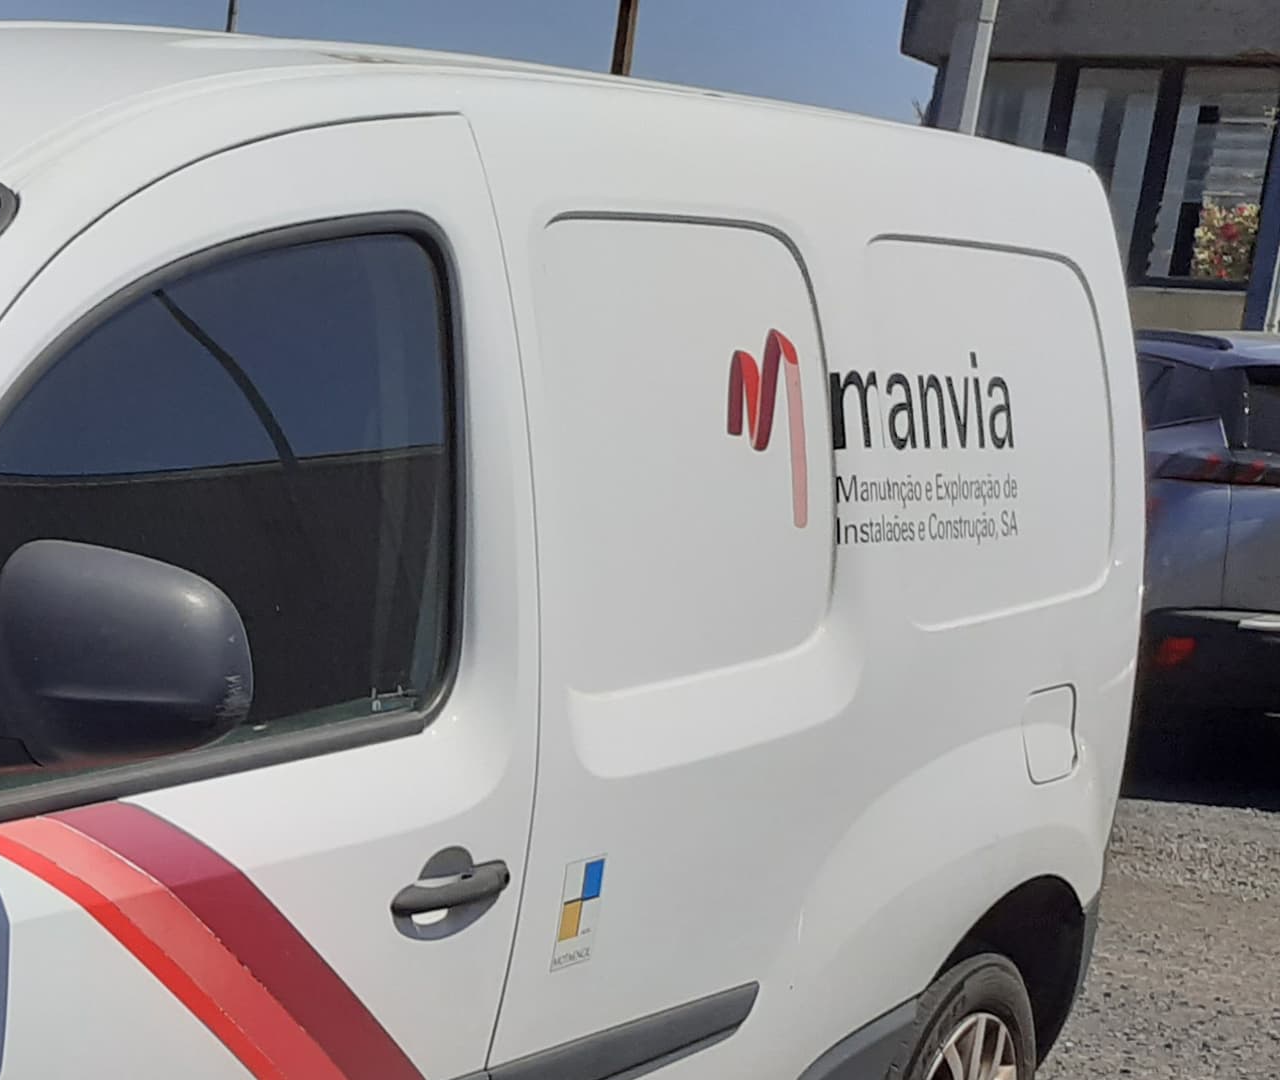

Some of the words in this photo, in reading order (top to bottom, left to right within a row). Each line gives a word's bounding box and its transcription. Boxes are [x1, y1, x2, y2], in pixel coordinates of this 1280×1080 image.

[829, 351, 1015, 450] manvia
[836, 474, 922, 509] Manutnção
[924, 480, 933, 502] e
[935, 472, 1002, 508] Exploração
[1002, 472, 1018, 499] de
[918, 519, 926, 542] e
[928, 512, 999, 547] Construção,
[1000, 509, 1018, 537] SA
